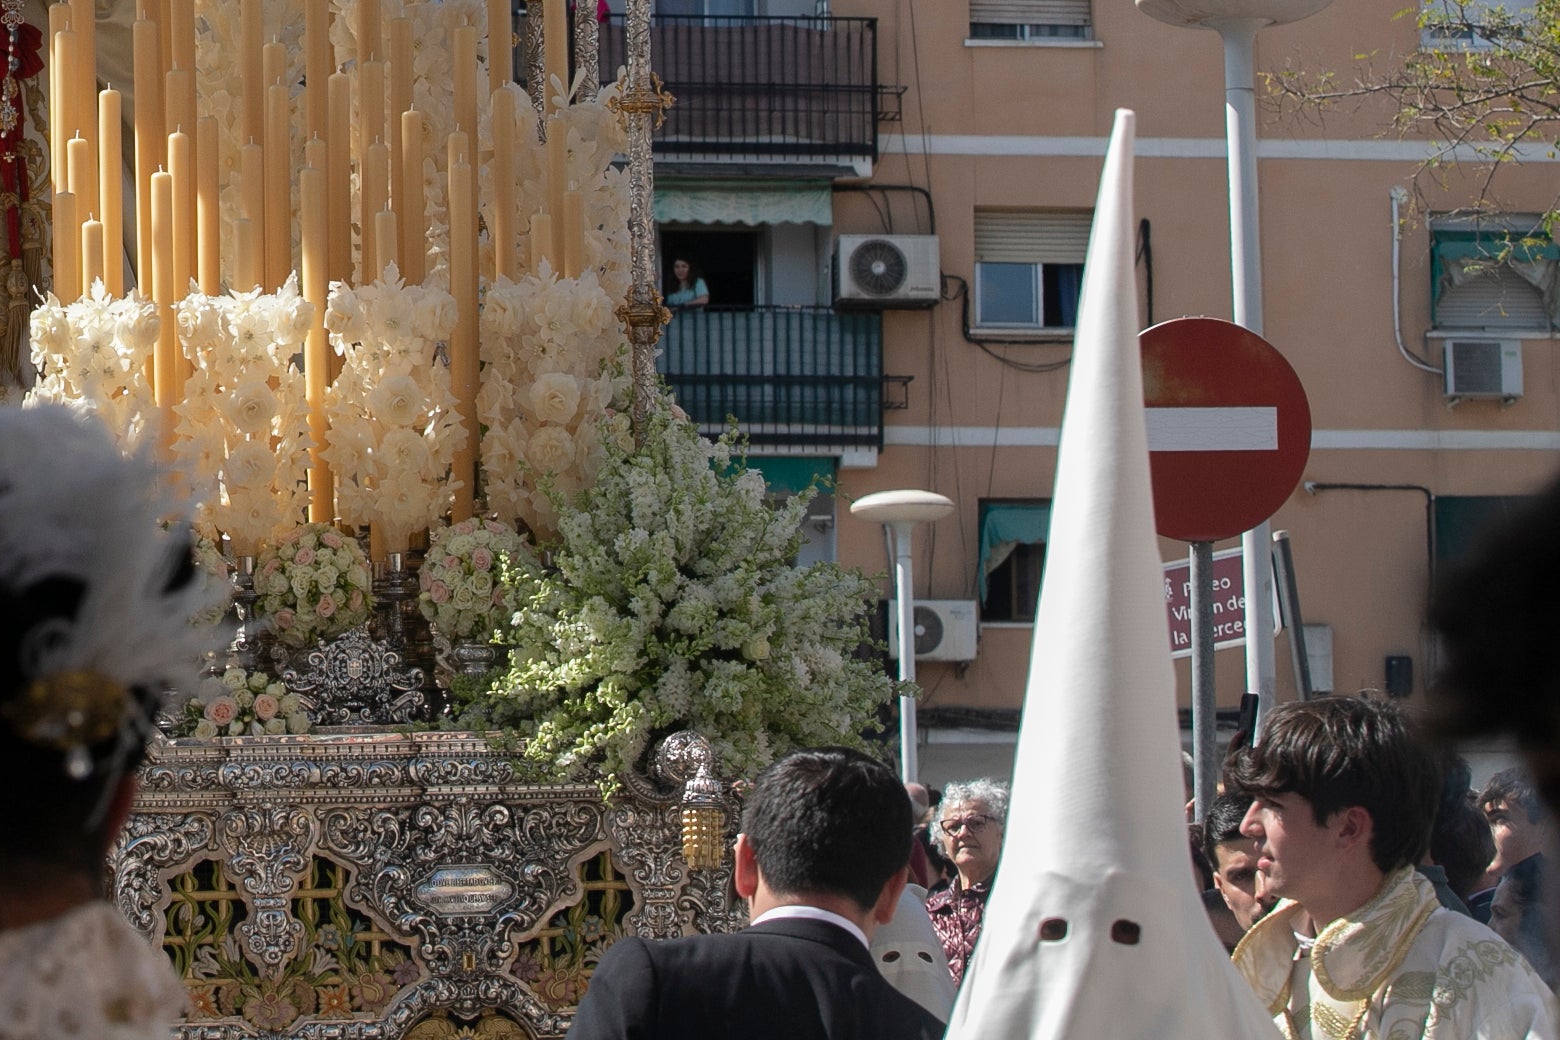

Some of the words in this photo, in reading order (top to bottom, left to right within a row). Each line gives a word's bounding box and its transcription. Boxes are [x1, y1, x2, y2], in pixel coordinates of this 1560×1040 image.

[1183, 577, 1231, 597] Peo
[1172, 602, 1224, 621] Virn
[1227, 595, 1246, 611] de
[1173, 630, 1189, 646] la
